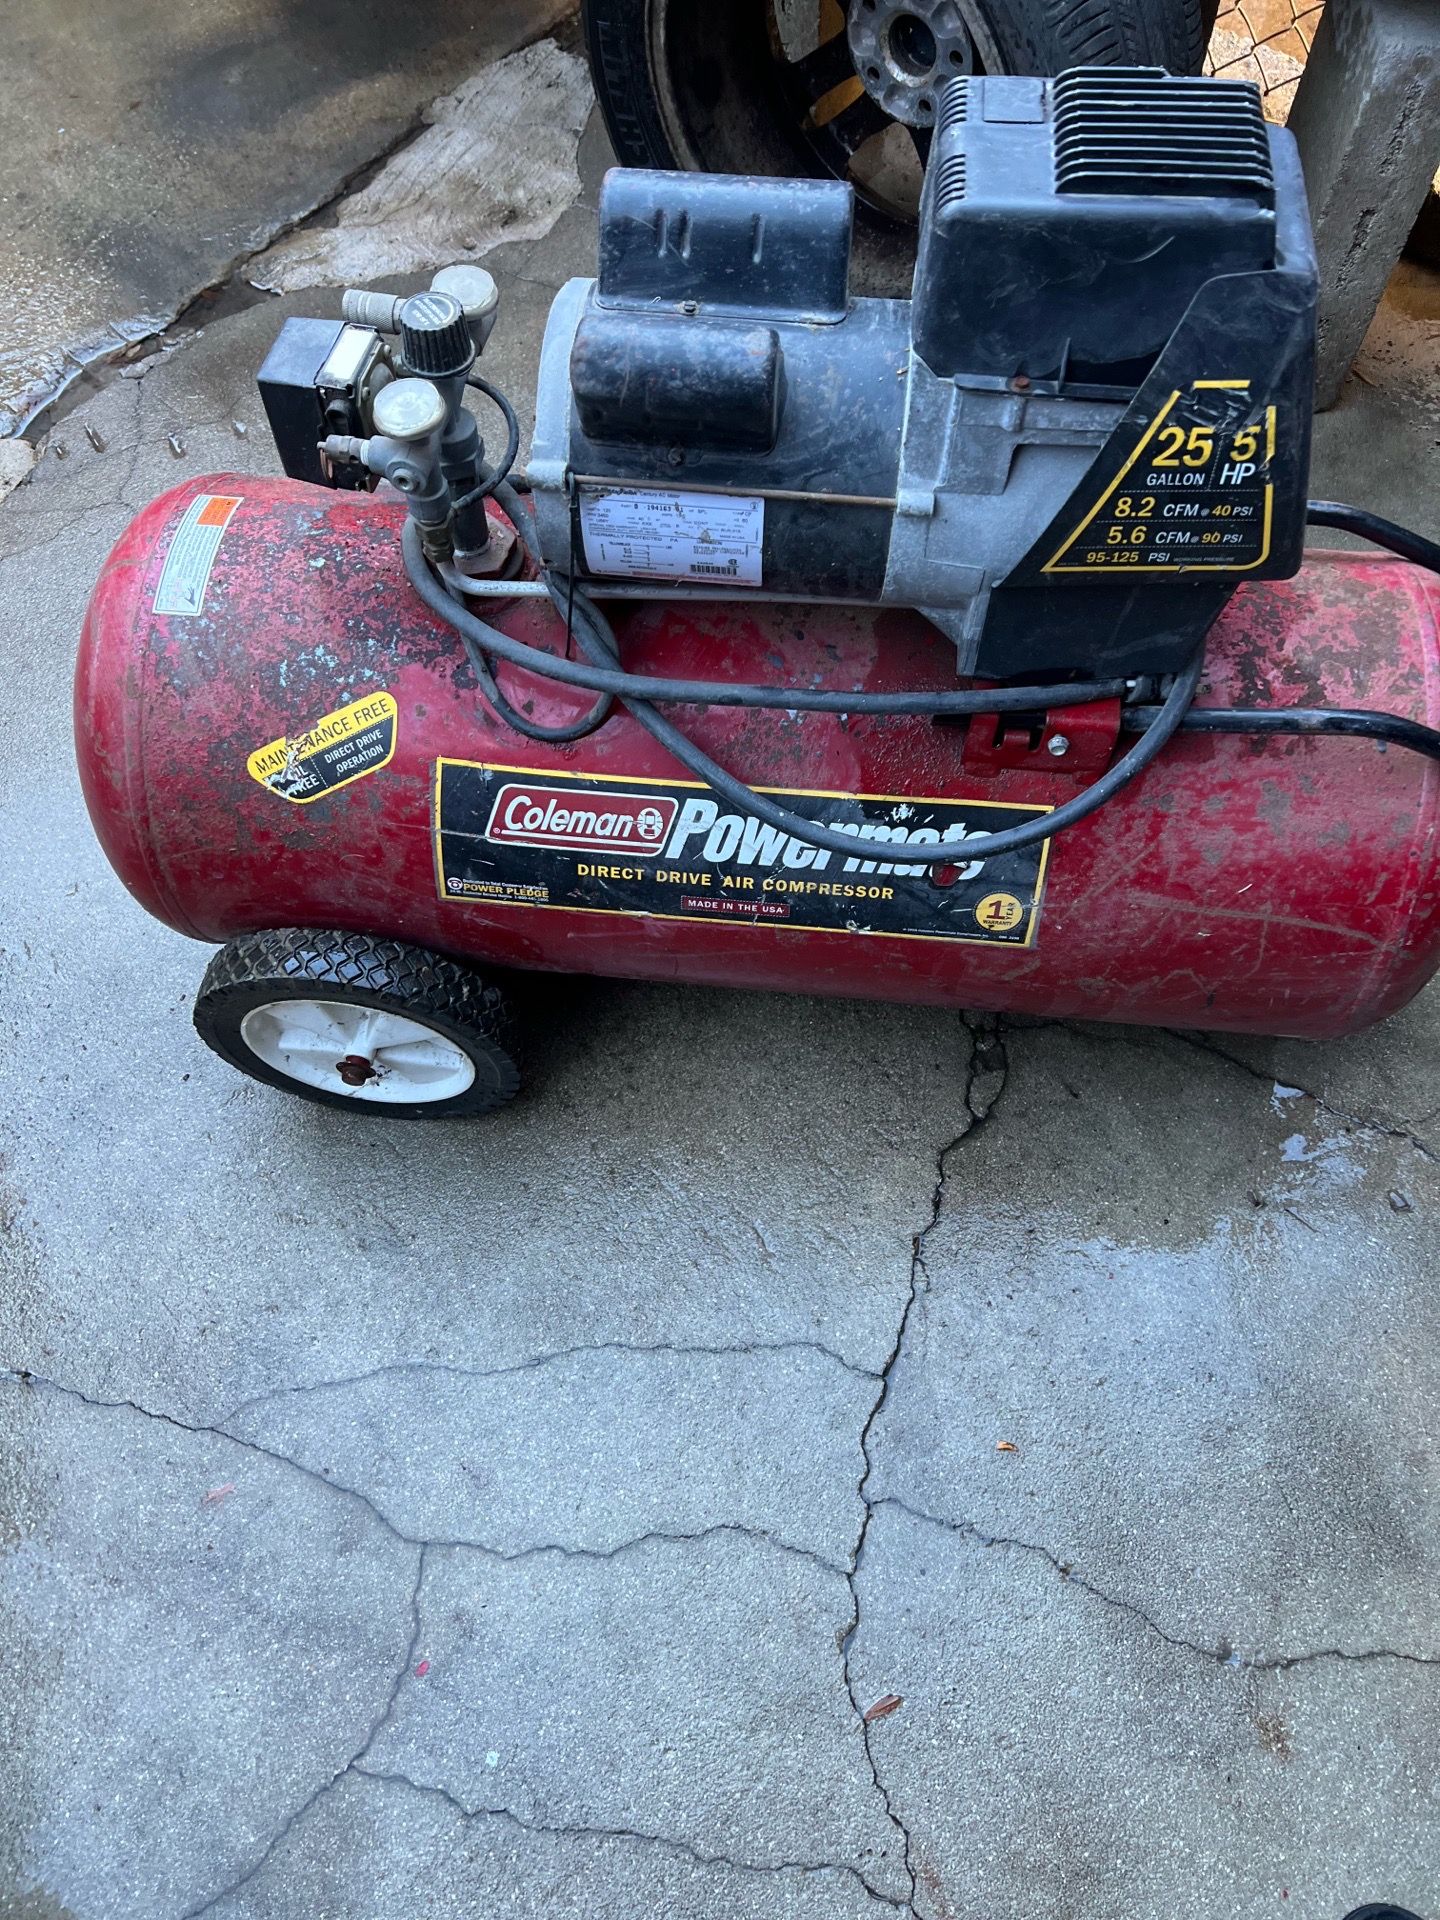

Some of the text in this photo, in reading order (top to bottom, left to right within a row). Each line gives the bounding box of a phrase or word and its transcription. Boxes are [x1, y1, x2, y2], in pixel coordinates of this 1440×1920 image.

[1151, 426, 1215, 467] 25
[1230, 425, 1262, 462] 5
[1146, 473, 1206, 486] GALLON
[1219, 463, 1256, 486] HP
[1114, 496, 1156, 518] 8.2
[1163, 504, 1199, 517] CFM
[1211, 505, 1232, 516] 40
[1233, 506, 1253, 517] PSI
[589, 531, 625, 539] THERMALLY
[626, 534, 662, 542] PROTECTED
[1106, 526, 1148, 545] 5.6
[1155, 531, 1190, 544] CFM
[1201, 533, 1221, 544] 90
[1222, 534, 1243, 543] PSI
[1086, 551, 1140, 564] 95-125
[1148, 553, 1170, 563] PSI
[255, 698, 391, 774] MAINTENANCE FREE
[324, 729, 384, 764] DIRECT DRIVE
[336, 743, 384, 773] OPERATION
[290, 773, 320, 795] FREE
[503, 794, 634, 839] Coleman
[463, 883, 550, 898] POWER PLEDGE
[577, 863, 895, 900] DIRECT DRIVE AIR COMPRESSOR
[687, 899, 783, 914] MADE IN THE USA
[986, 900, 1006, 920] 1
[1004, 902, 1016, 920] YEAR
[982, 919, 1013, 927] WARRANTY
